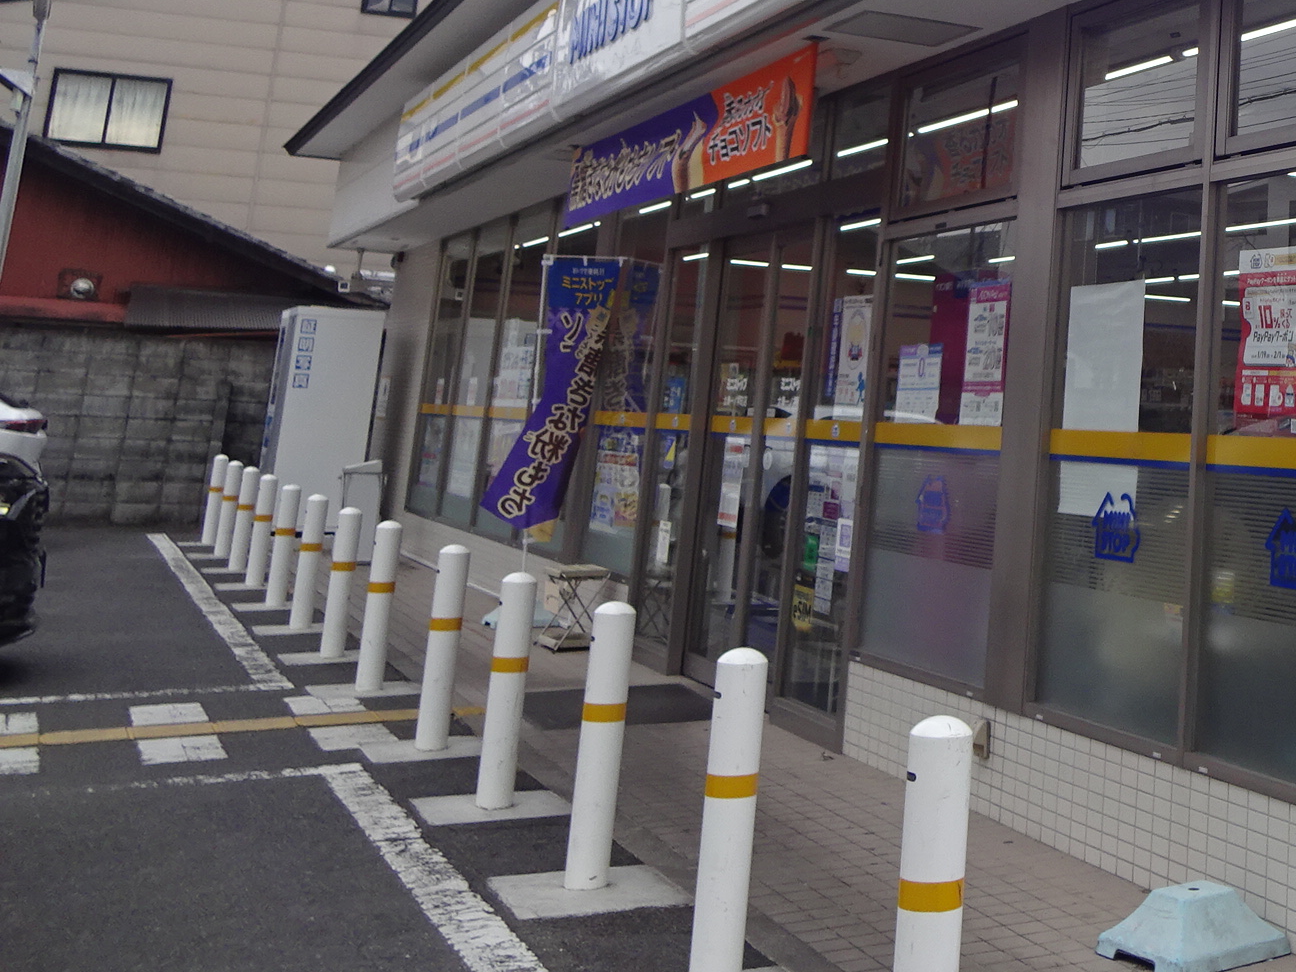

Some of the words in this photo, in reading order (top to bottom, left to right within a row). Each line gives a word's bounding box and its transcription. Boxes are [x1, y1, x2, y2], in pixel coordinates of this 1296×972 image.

[707, 112, 773, 166] チョコソフト
